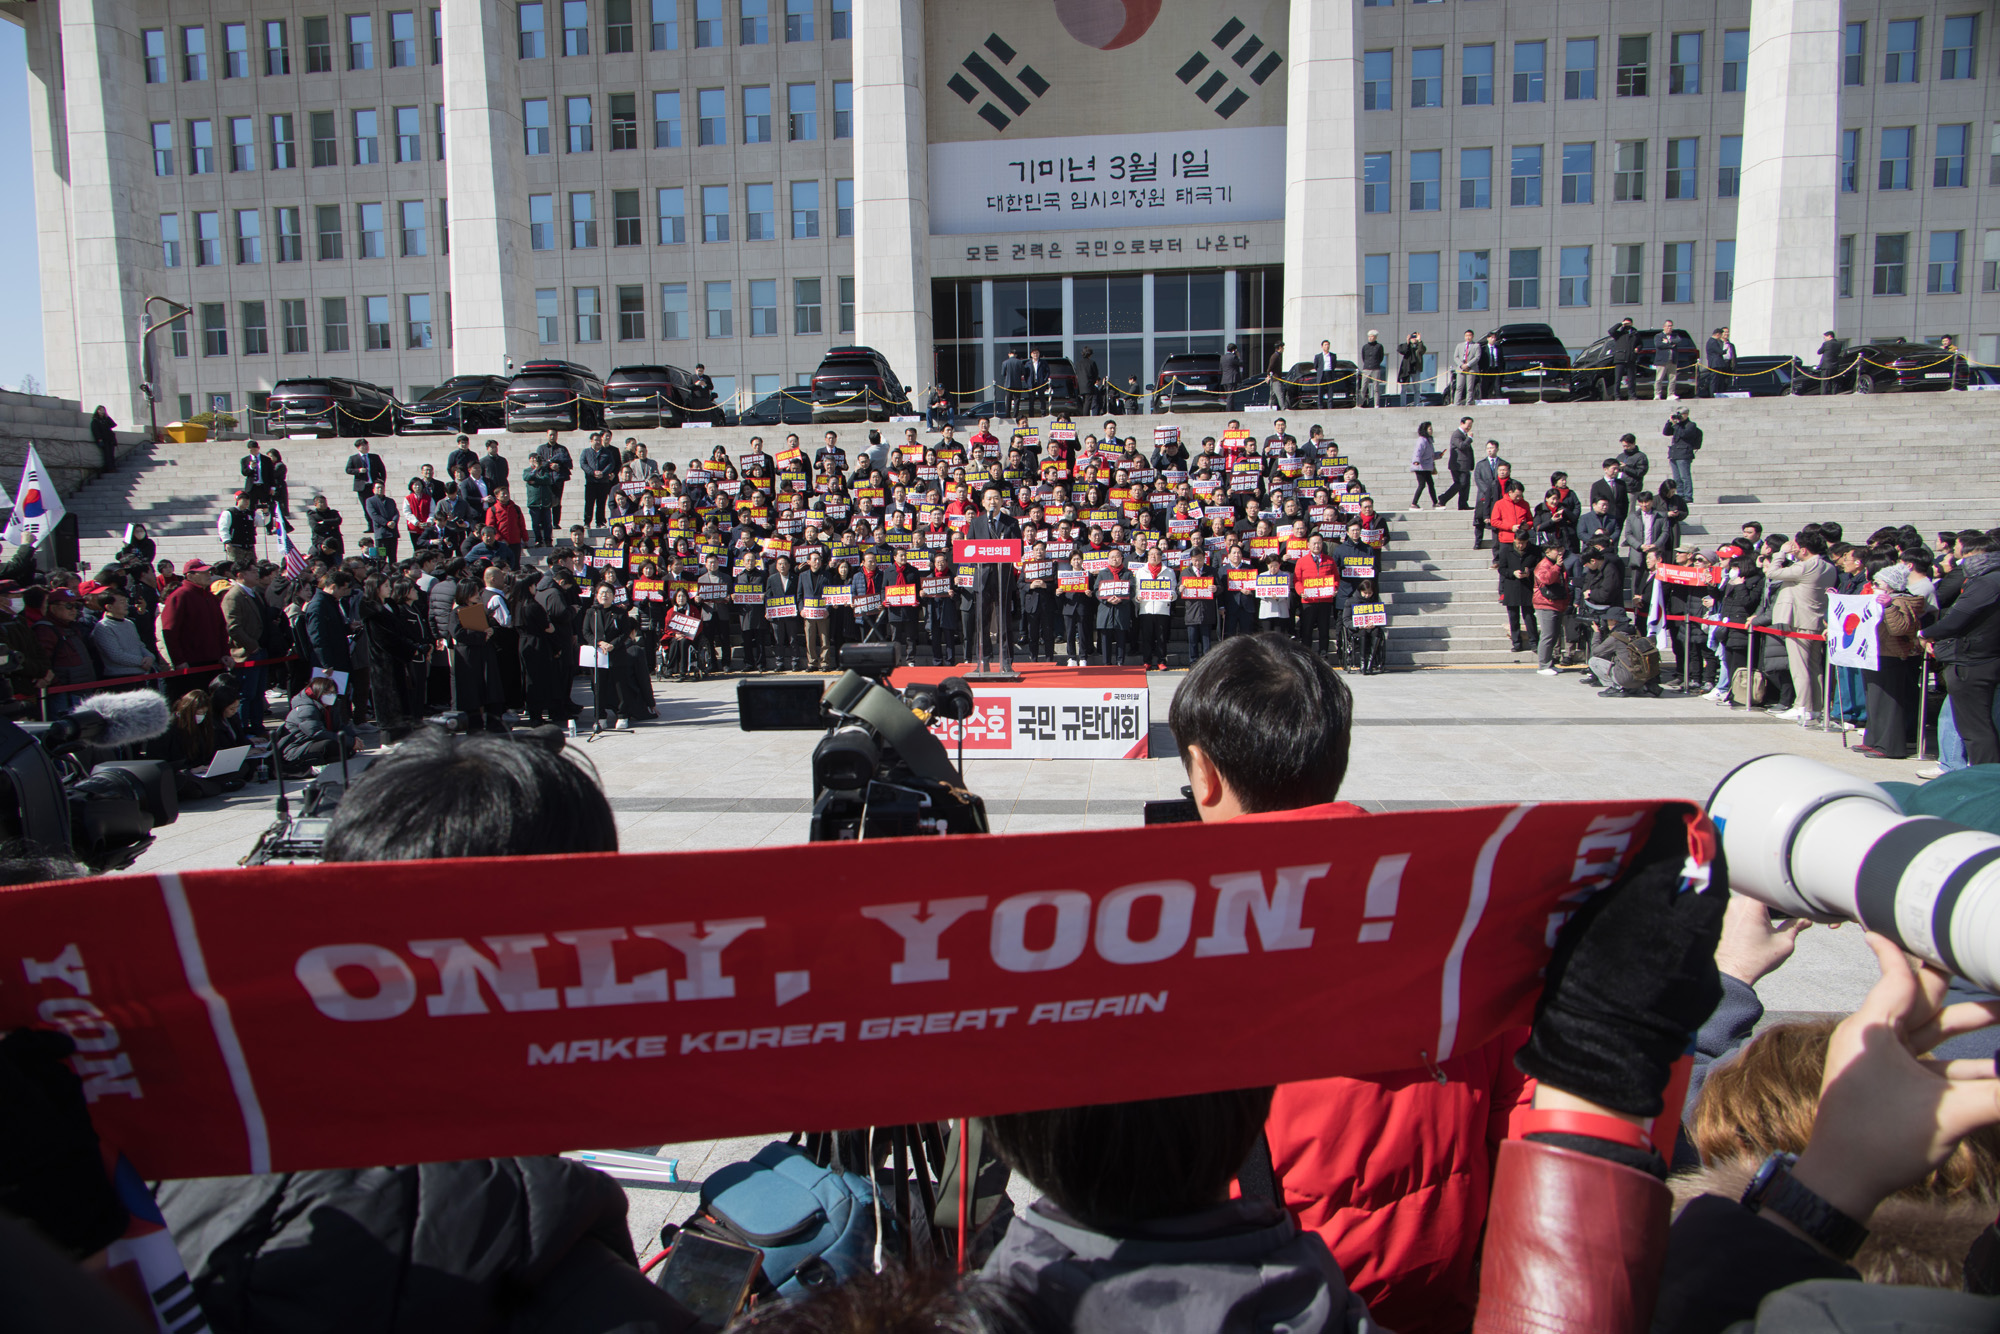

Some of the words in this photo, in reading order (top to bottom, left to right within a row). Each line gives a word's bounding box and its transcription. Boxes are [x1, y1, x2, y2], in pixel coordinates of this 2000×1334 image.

[1008, 155, 1096, 184] 기미년
[1109, 152, 1158, 182] 3월
[987, 192, 1061, 213] 대한민국
[1070, 188, 1165, 210] 임시의정원
[1175, 186, 1232, 205] 태극기
[966, 244, 999, 262] 모든
[1011, 242, 1063, 260] 권력은
[1075, 238, 1182, 257] 국민으로부터
[1197, 234, 1250, 253] 나온다
[978, 546, 1011, 556] 국민의힘
[1018, 705, 1056, 741] 국민
[1061, 705, 1139, 741] 규탄대회
[295, 916, 810, 1021] ONLY,
[860, 863, 1331, 984] YOON
[528, 1035, 667, 1065] MAKE
[681, 1022, 845, 1055] KOREA
[858, 1006, 1018, 1040] GREAT
[1027, 990, 1168, 1025] AGAIN
